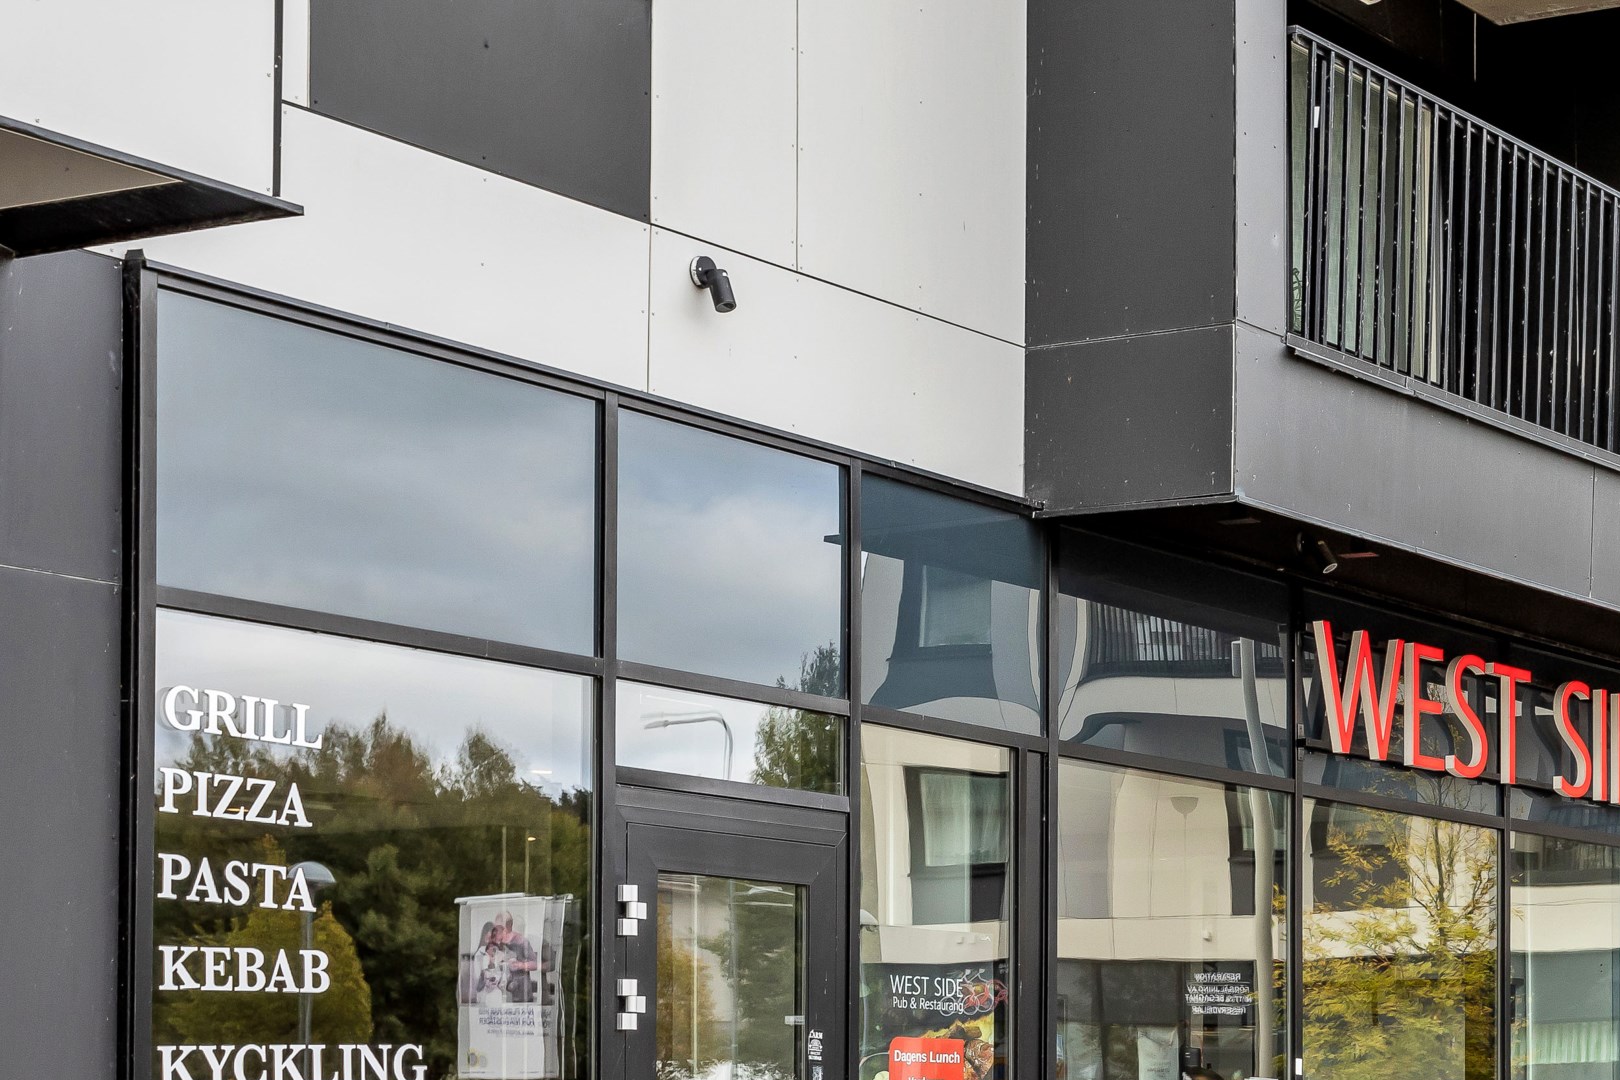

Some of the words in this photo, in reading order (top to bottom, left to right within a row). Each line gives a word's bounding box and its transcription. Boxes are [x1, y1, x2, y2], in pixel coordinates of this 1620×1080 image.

[164, 684, 323, 750] GRILL
[1312, 619, 1532, 786] WEST
[159, 767, 313, 828] PIZZA
[157, 853, 317, 913] PASTA
[158, 945, 331, 994] KEBAB
[890, 974, 930, 996] WEST
[934, 977, 963, 998] SIDE
[893, 996, 908, 1009] Pub
[910, 998, 917, 1009] &
[919, 998, 964, 1014] Restaurang
[894, 1050, 927, 1065] Dagens
[929, 1050, 960, 1064] Lunch
